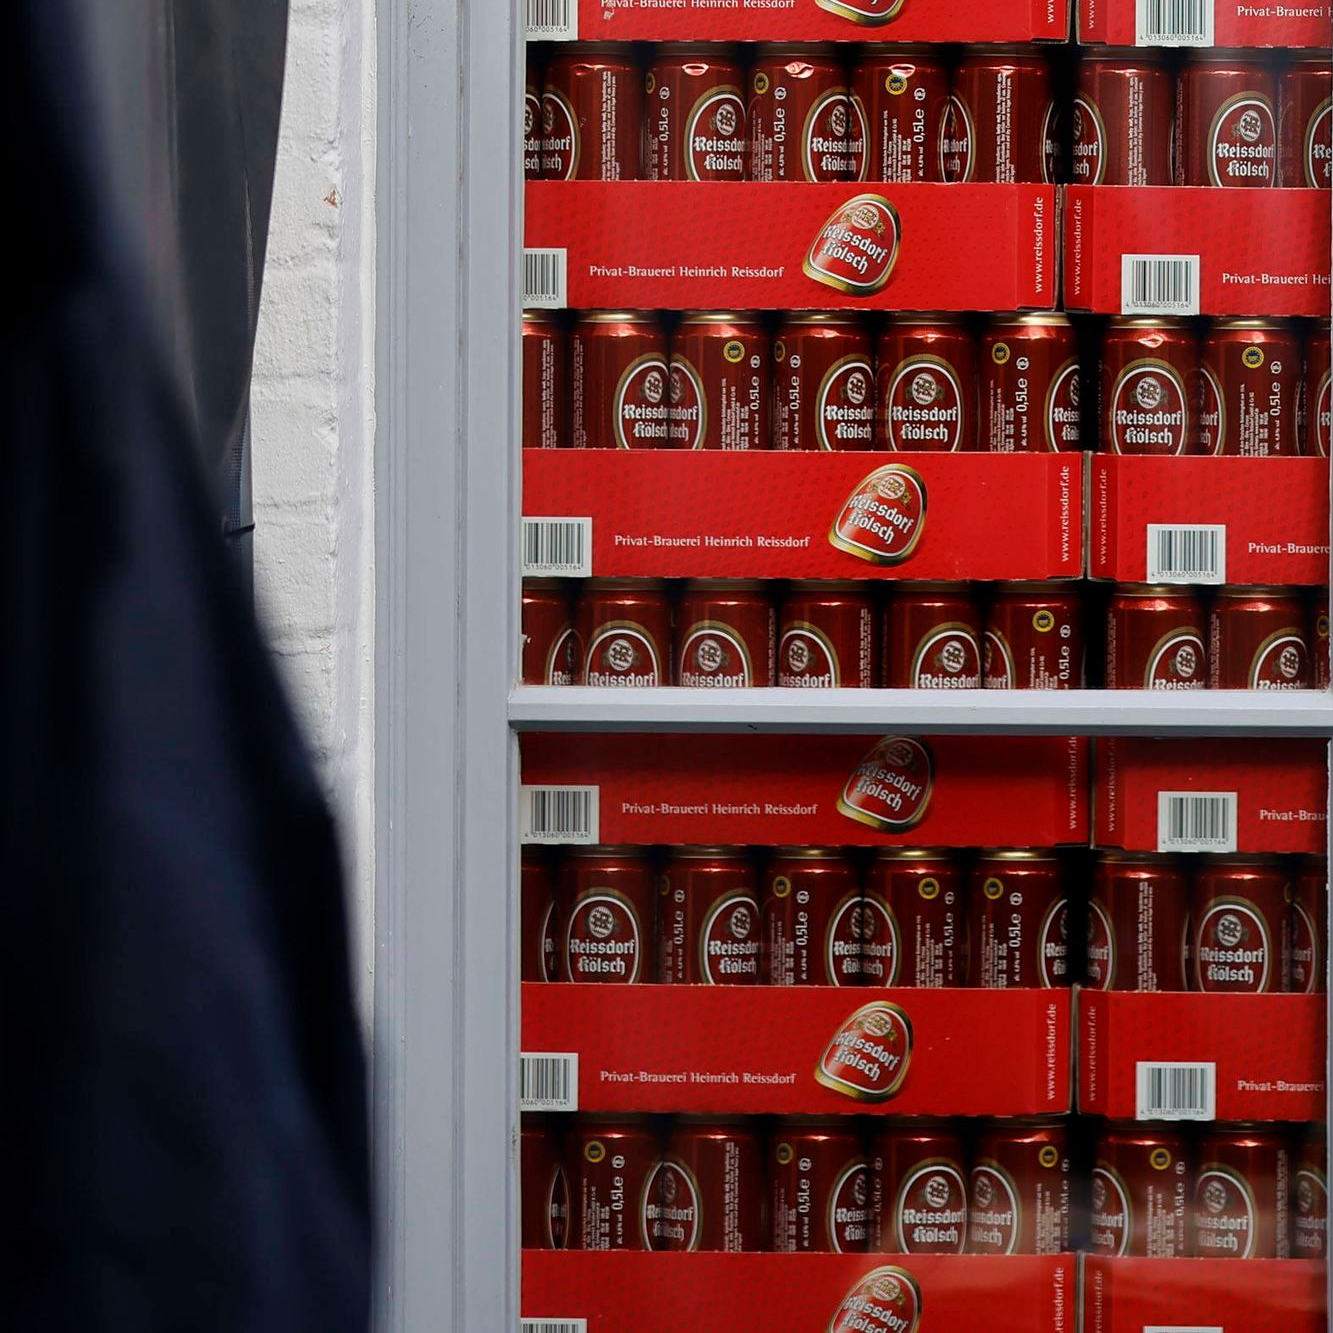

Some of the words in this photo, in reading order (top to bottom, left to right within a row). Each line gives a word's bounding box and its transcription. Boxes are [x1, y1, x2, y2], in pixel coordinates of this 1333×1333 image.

[1237, 5, 1323, 18] Privat-Brauerei
[823, 223, 888, 262] Reissdorf
[1034, 197, 1043, 293] www.reissdorf.de
[1073, 199, 1082, 295] www.reissdorf.de
[822, 240, 868, 273] Kölsch
[590, 266, 675, 278] Privat-Brauerei
[679, 266, 728, 278] Heinrich
[732, 266, 784, 278] Reissdorf
[1222, 273, 1307, 286] Privat-Brauerei
[893, 405, 958, 422] Reissdorf
[1117, 409, 1182, 426] Reissdorf
[901, 423, 949, 443] Kölsch
[1125, 427, 1172, 446] Kölsch
[849, 493, 914, 532] Reissdorf
[1059, 466, 1070, 562] www.reissdorf.de
[1098, 468, 1107, 565] www.reissdorf.de
[848, 511, 894, 544] Kölsch
[615, 535, 700, 548] Privat-Brauerei
[705, 535, 753, 548] Heinrich
[757, 535, 810, 548] Reissdorf
[857, 764, 922, 801] Reissdorf
[856, 779, 902, 811] Kölsch
[622, 803, 708, 816] Privat-Brauerei
[713, 803, 761, 816] Heinrich
[765, 803, 818, 816] Reissdorf
[570, 940, 635, 956] Reissdorf
[1201, 948, 1264, 964] Reissdorf
[578, 957, 625, 976] Kölsch
[1207, 965, 1254, 984] Kölsch
[836, 1029, 901, 1068] Reissdorf
[1046, 1004, 1056, 1100] www.reissdorf.de
[834, 1048, 881, 1081] Kölsch
[601, 1071, 687, 1084] Privat-Brauerei
[691, 1071, 739, 1084] Heinrich
[743, 1071, 796, 1084] Reissdorf
